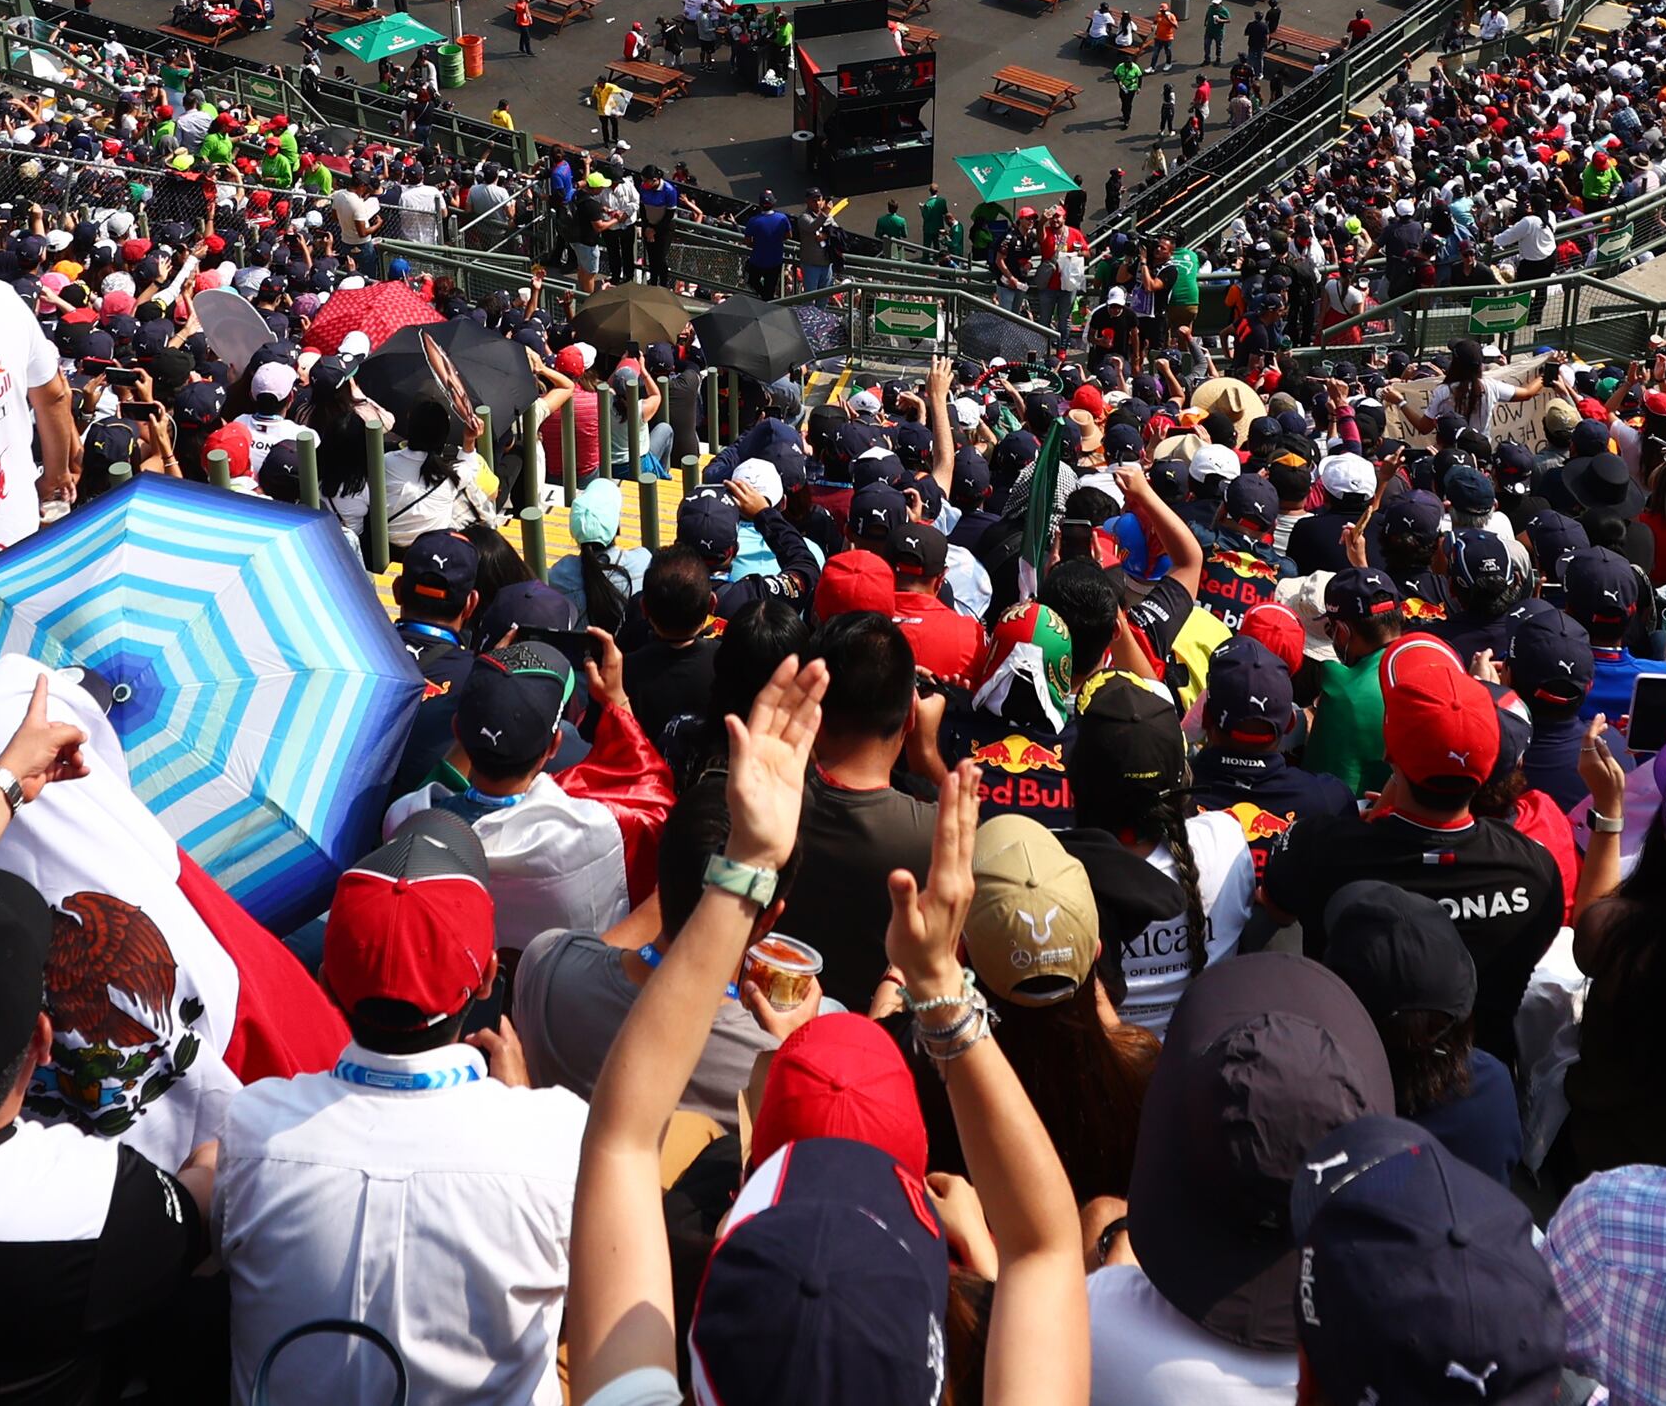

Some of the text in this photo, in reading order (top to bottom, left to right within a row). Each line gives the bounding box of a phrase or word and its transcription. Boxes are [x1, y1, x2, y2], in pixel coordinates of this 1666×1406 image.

[1222, 756, 1266, 768] HONDA
[976, 778, 1014, 805] ed
[1121, 917, 1217, 963] xican
[1130, 965, 1146, 977] OF
[1300, 1245, 1322, 1327] telcel
